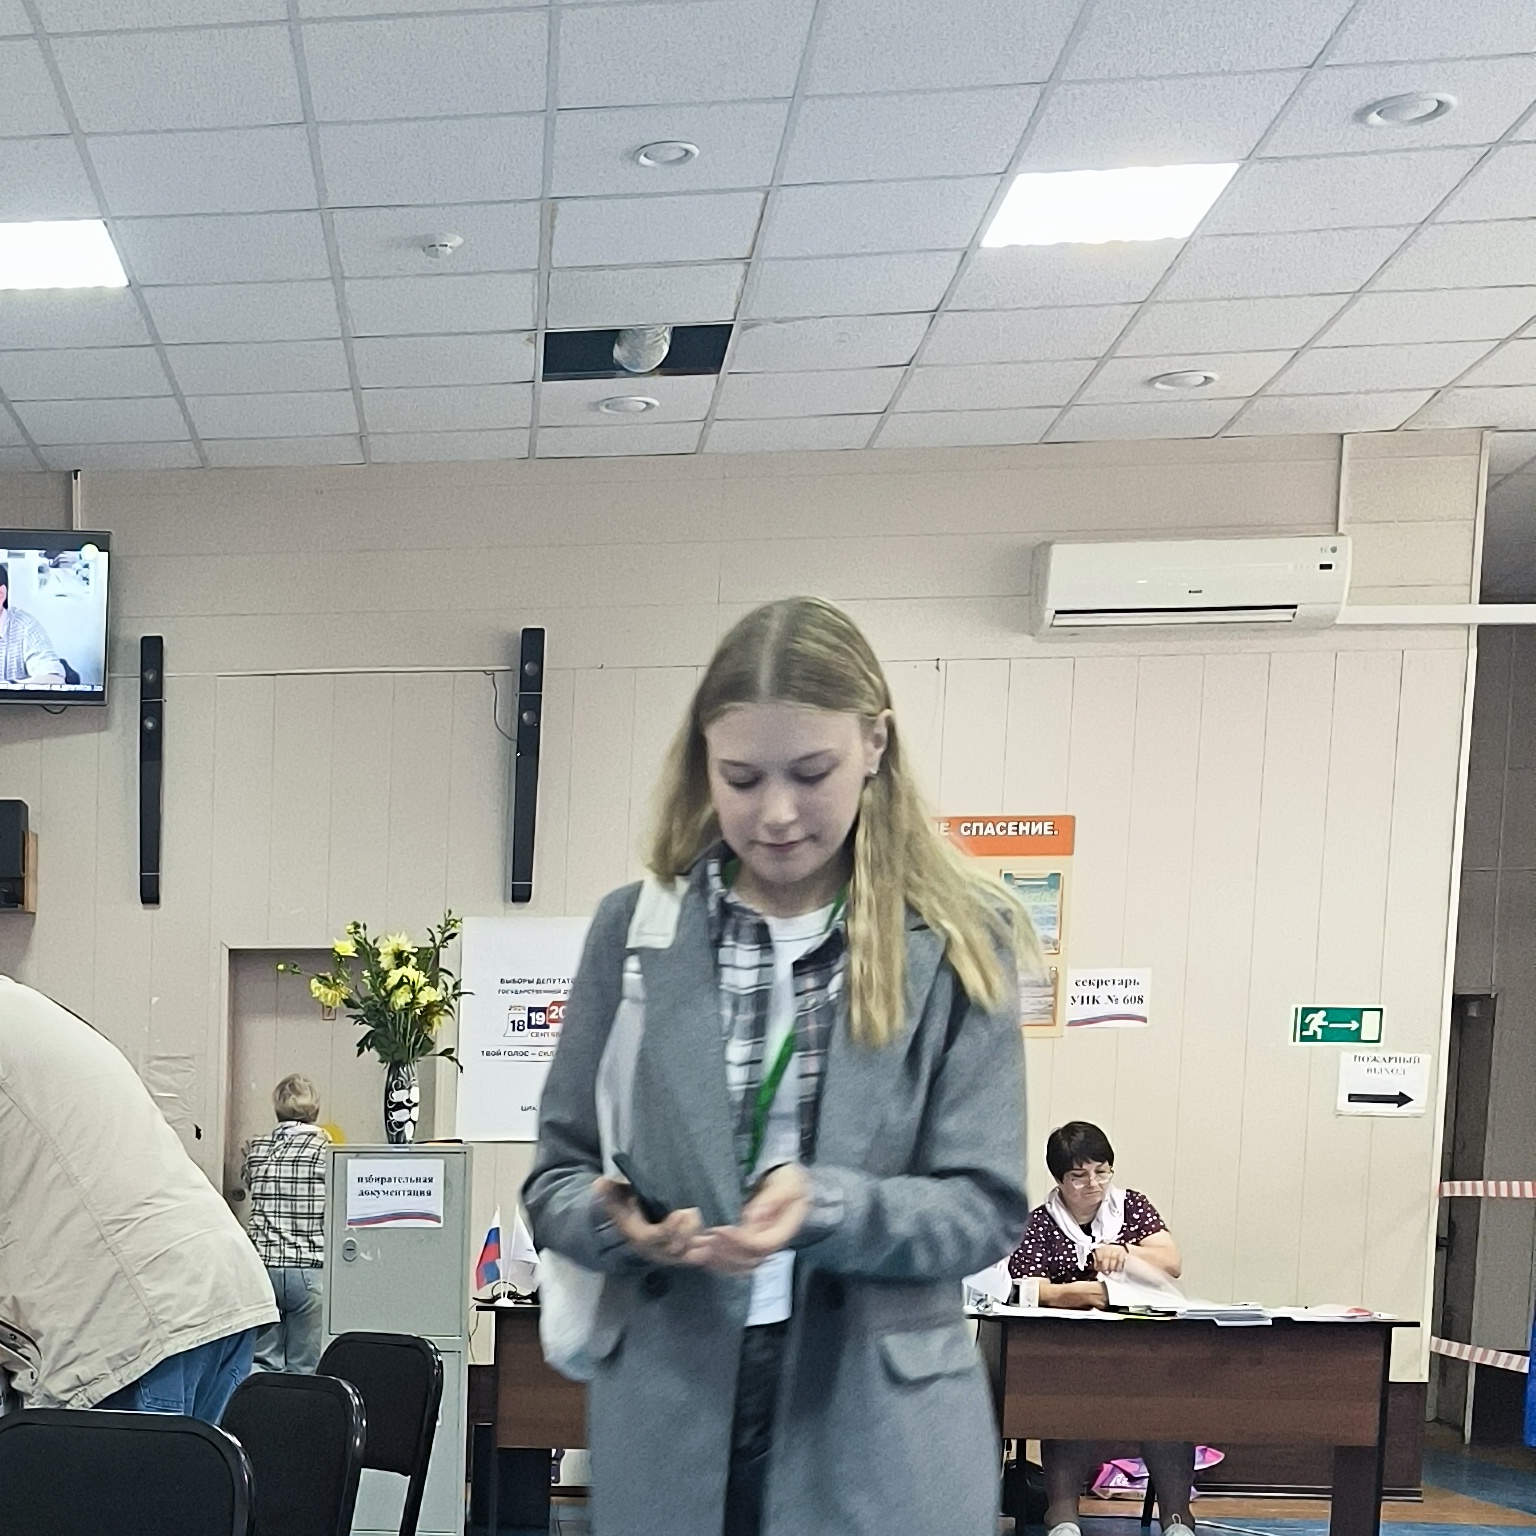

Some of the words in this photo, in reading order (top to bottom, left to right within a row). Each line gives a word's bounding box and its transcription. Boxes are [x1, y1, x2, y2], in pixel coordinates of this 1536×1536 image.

[960, 821, 1059, 836] СПАСЕНИЕ.
[1075, 978, 1140, 989] секретарь
[1070, 995, 1101, 1005] УИК
[1104, 995, 1119, 1005] №
[1123, 995, 1144, 1005] 608
[549, 1006, 567, 1019] 20
[529, 1011, 546, 1026] 19
[510, 1020, 526, 1032] 18
[481, 1048, 502, 1057] ТВОЙ
[1354, 1055, 1420, 1064] ПОЖАРНЫЙ
[1366, 1067, 1406, 1075] ВЫХОД
[357, 1175, 434, 1186] избирательная
[358, 1188, 432, 1198] документация
